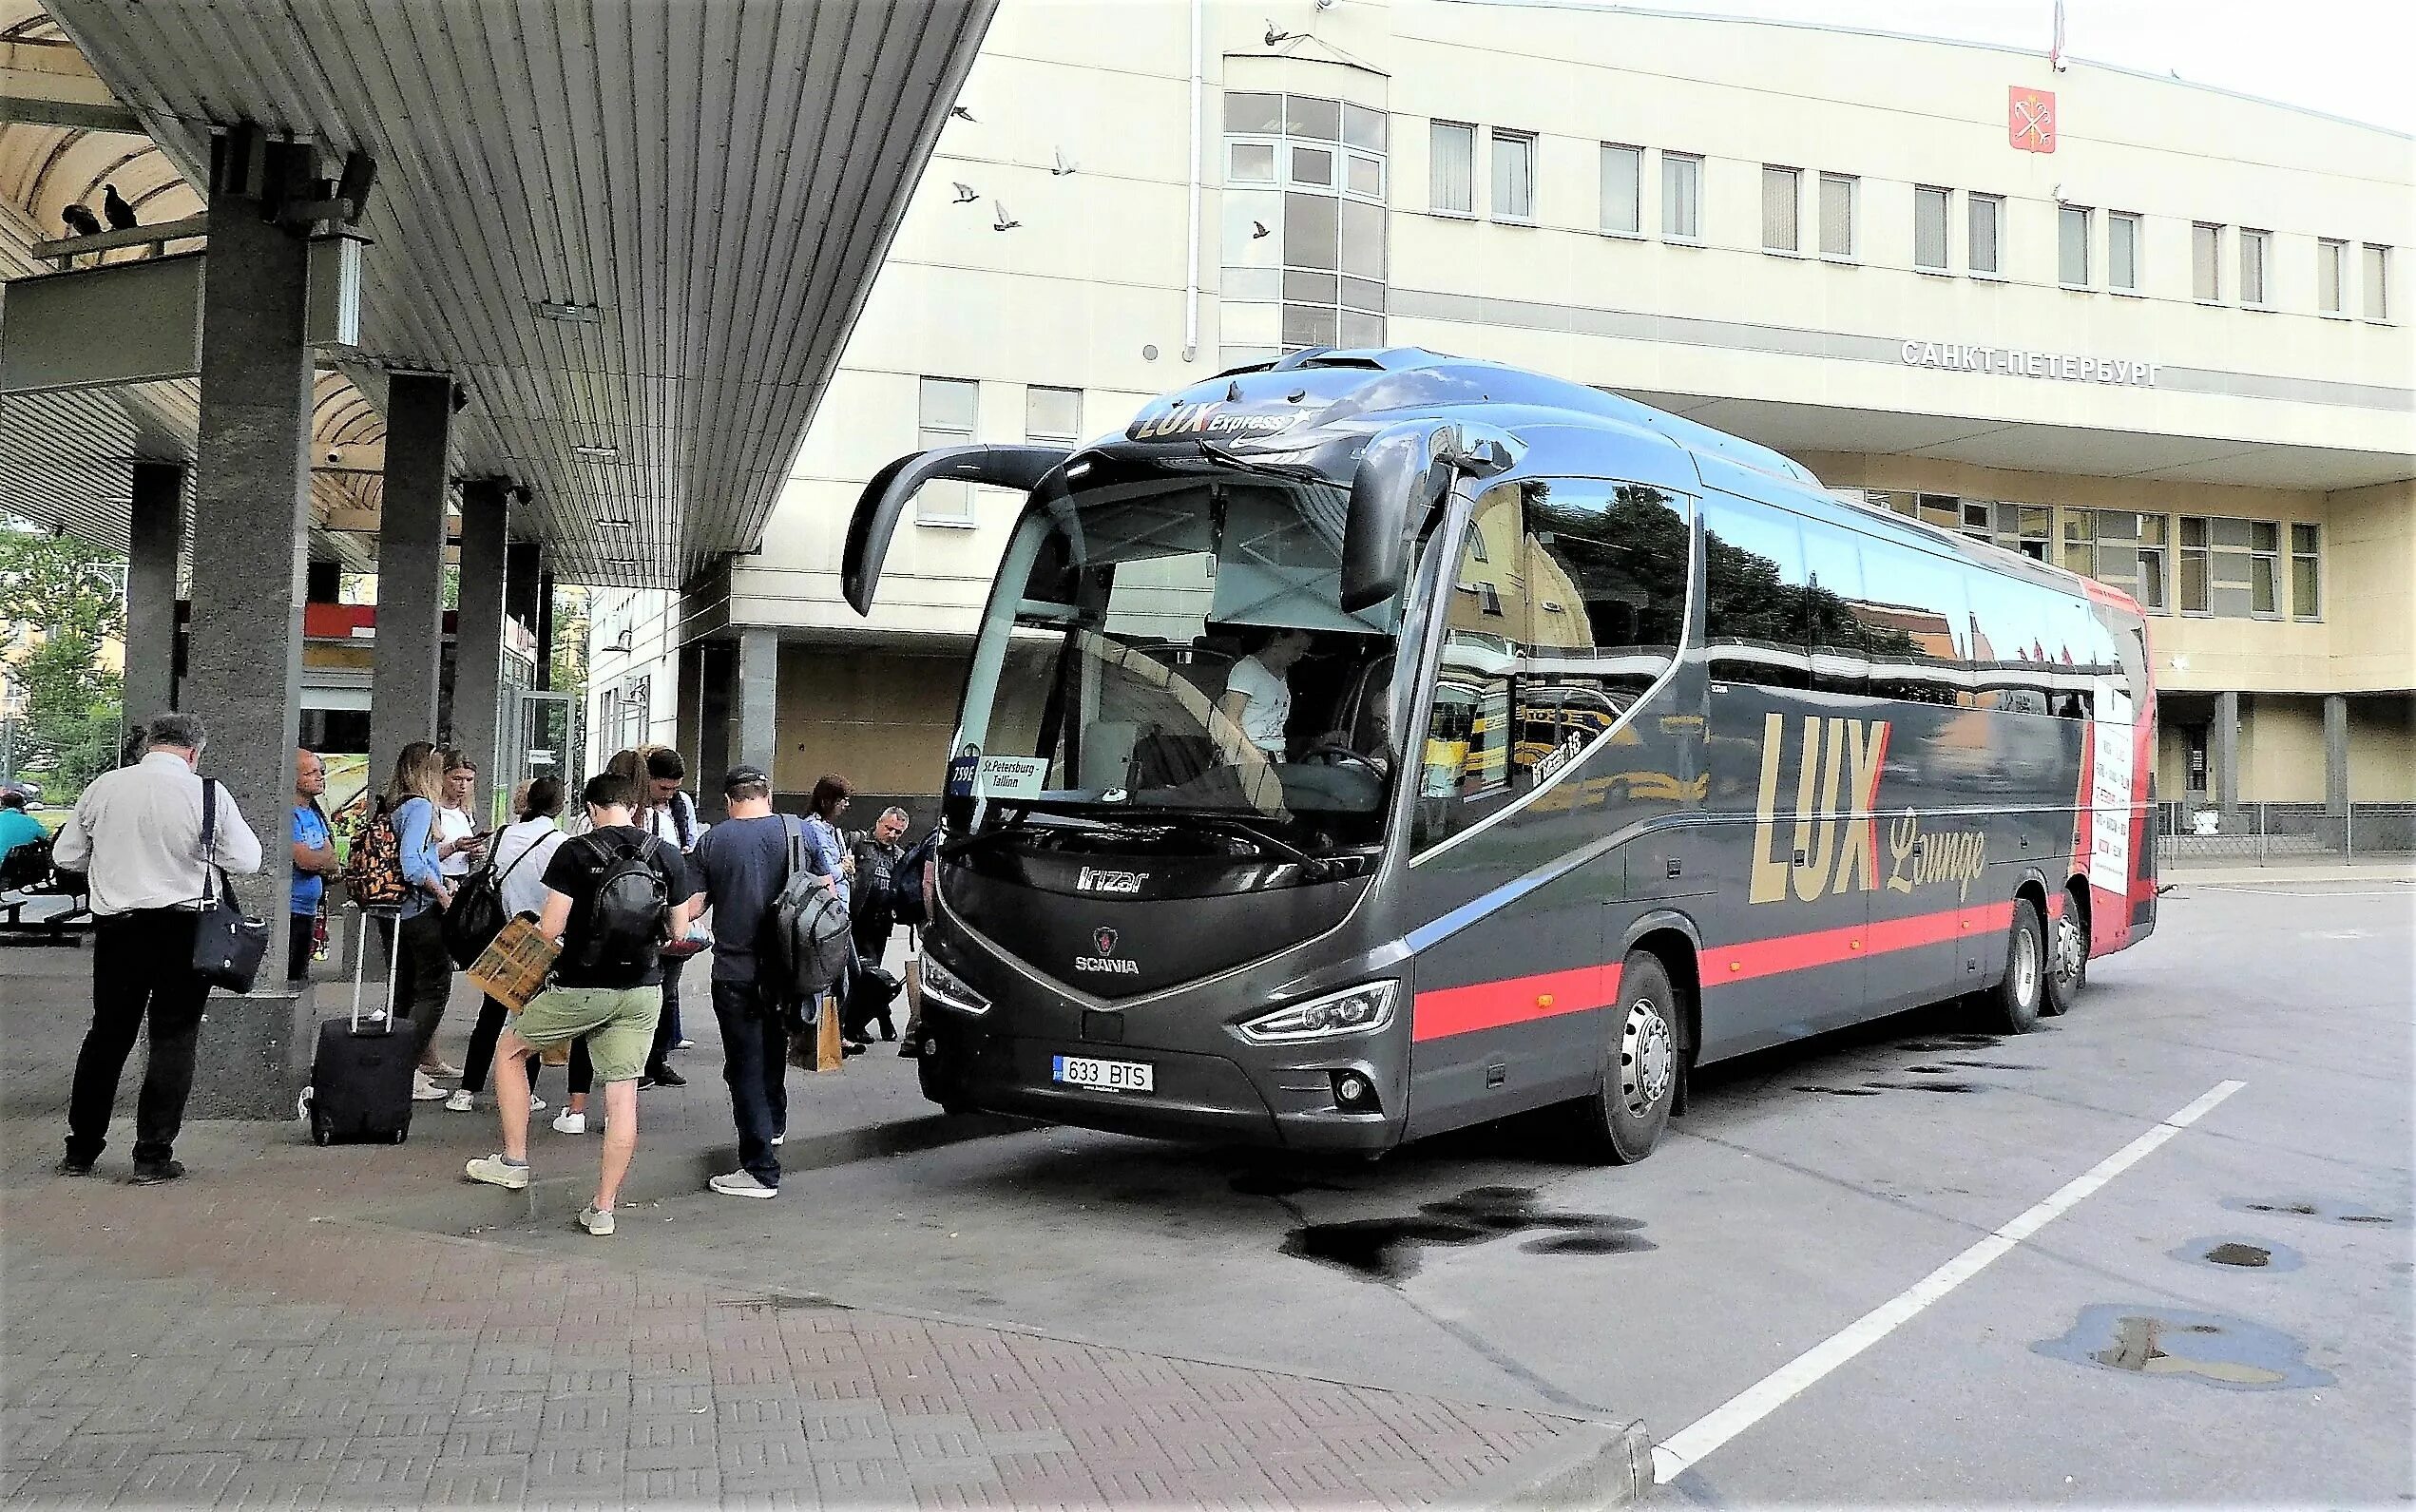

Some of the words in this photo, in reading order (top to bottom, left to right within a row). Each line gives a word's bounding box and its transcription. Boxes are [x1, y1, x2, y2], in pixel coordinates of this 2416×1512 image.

[1901, 339, 2162, 386] САНКТ-ПЕТЕРБУРГ
[1135, 401, 1224, 440] LUX
[1207, 412, 1285, 434] Express
[992, 774, 1019, 788] Tallinn
[1749, 712, 1891, 905] LUX
[1887, 805, 1985, 903] Lounge
[1074, 956, 1140, 974] SCANIA
[1068, 1061, 1099, 1081] 633
[1109, 1064, 1145, 1086] BTS
